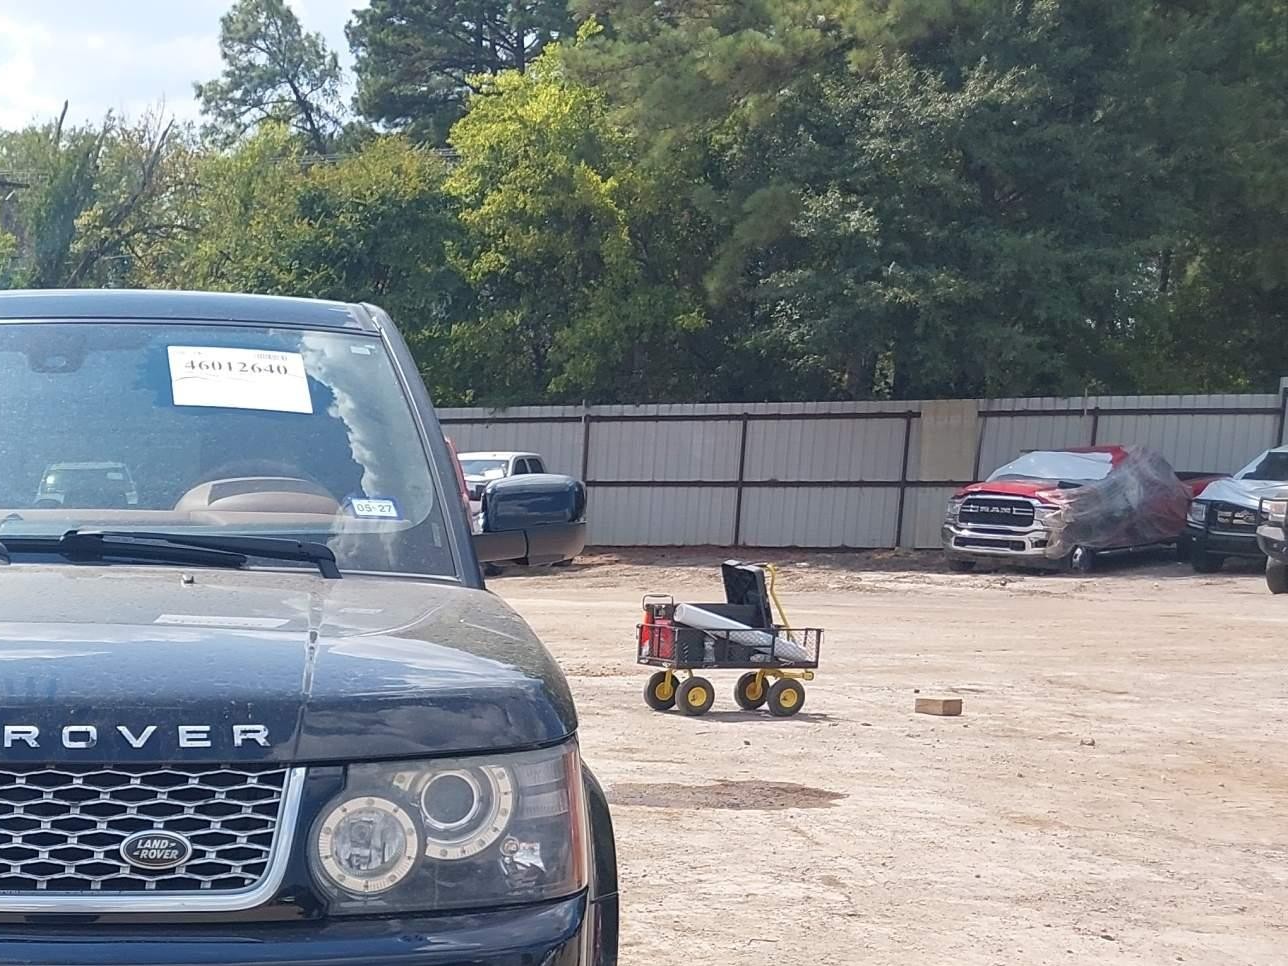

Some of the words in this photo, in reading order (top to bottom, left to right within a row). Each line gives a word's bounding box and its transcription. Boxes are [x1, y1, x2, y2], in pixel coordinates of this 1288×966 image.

[184, 359, 288, 375] 46012640
[979, 505, 1011, 514] RAM
[3, 724, 271, 748] ROVER
